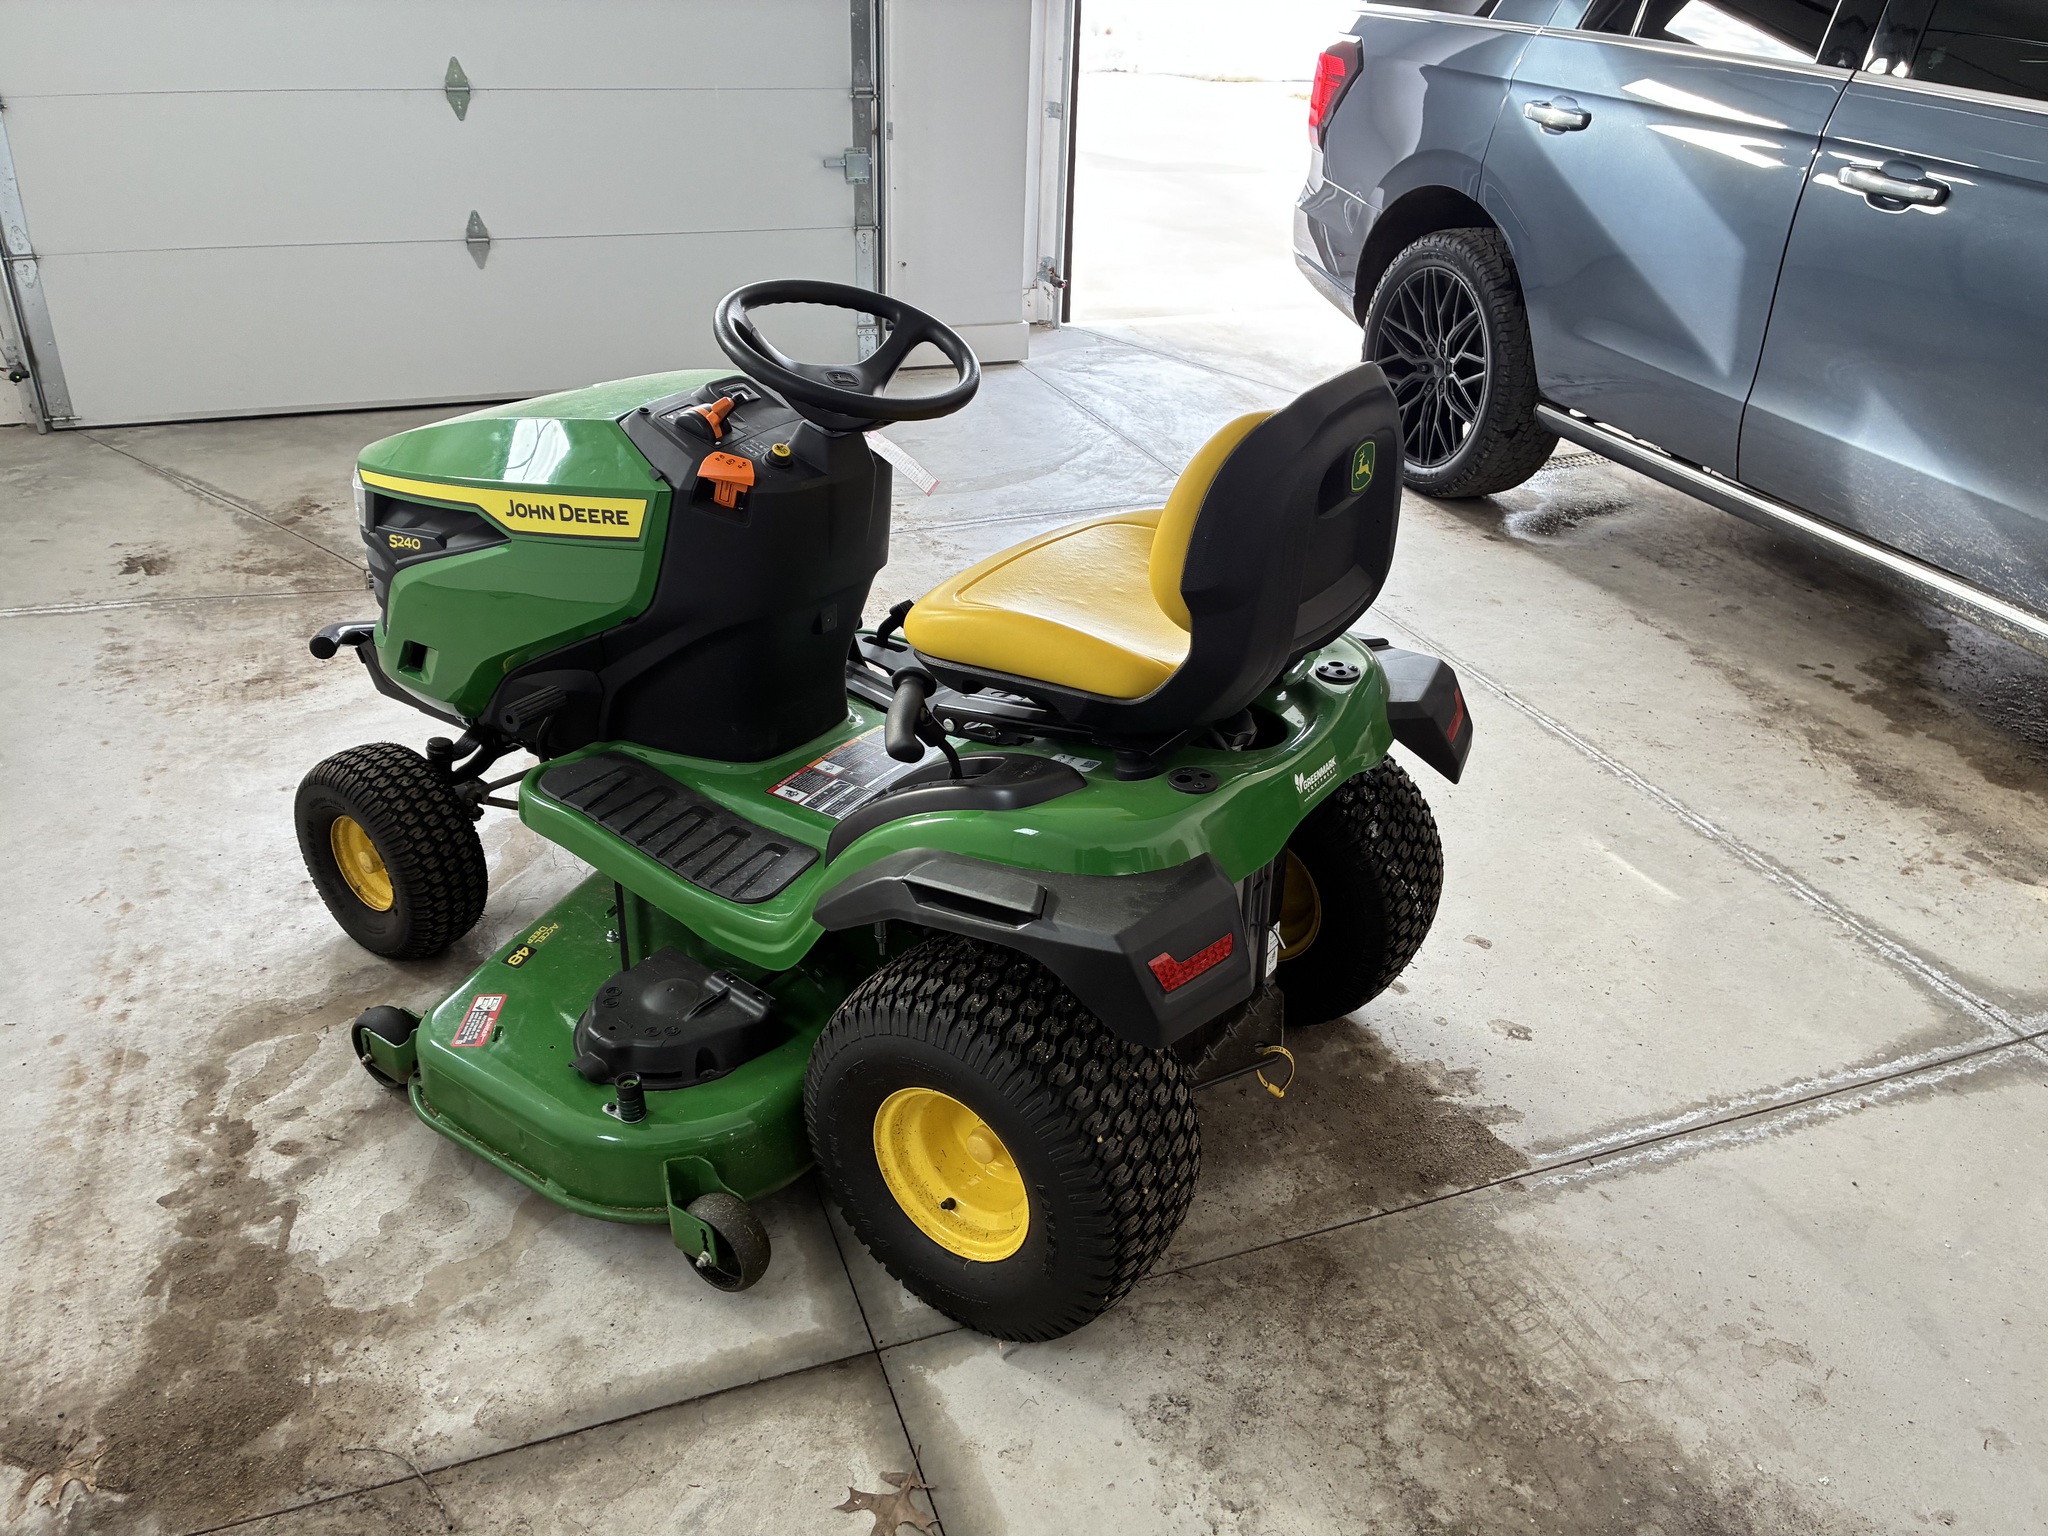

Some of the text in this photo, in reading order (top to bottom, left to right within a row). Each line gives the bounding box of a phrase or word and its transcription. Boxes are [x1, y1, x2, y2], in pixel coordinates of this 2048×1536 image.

[506, 499, 630, 526] JOHN DEERE
[389, 534, 421, 550] S240
[1303, 755, 1337, 790] GREENMARK
[527, 925, 548, 944] DEEP
[534, 922, 559, 943] ACCEL
[507, 946, 529, 966] 48
